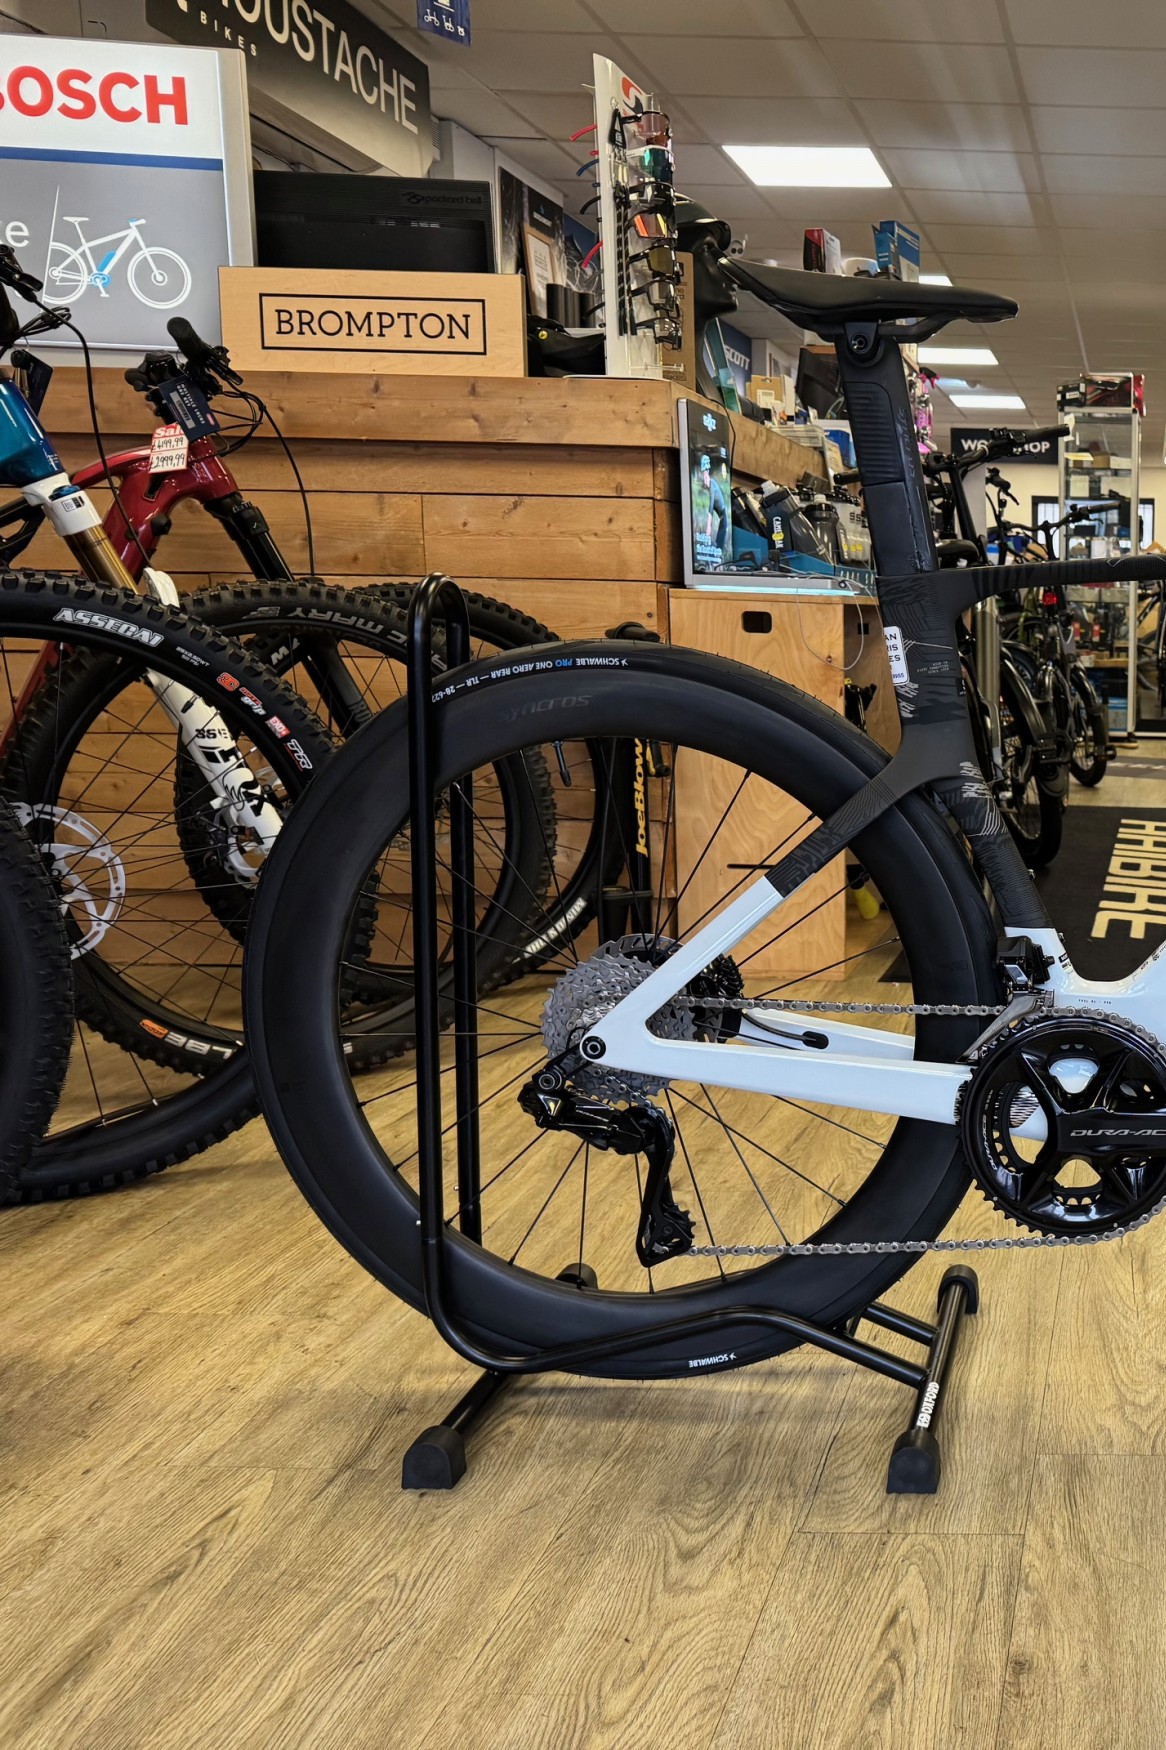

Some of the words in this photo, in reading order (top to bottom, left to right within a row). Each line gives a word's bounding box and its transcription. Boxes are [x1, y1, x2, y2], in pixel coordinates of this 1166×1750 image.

[199, 10, 257, 57] BIKES
[221, 0, 418, 135] USTACHE
[0, 65, 188, 126] OSCH
[275, 309, 470, 339] BROMPTON
[53, 608, 164, 647] ASSEGAI
[512, 663, 534, 675] AERO
[535, 661, 554, 670] ONE
[554, 657, 573, 667] PRO
[575, 657, 620, 667] SCHWALBE
[490, 667, 511, 679] REAR
[466, 676, 480, 687] TLR
[688, 1353, 729, 1368] SCHWALBE
[922, 1381, 940, 1414] OXFORD
